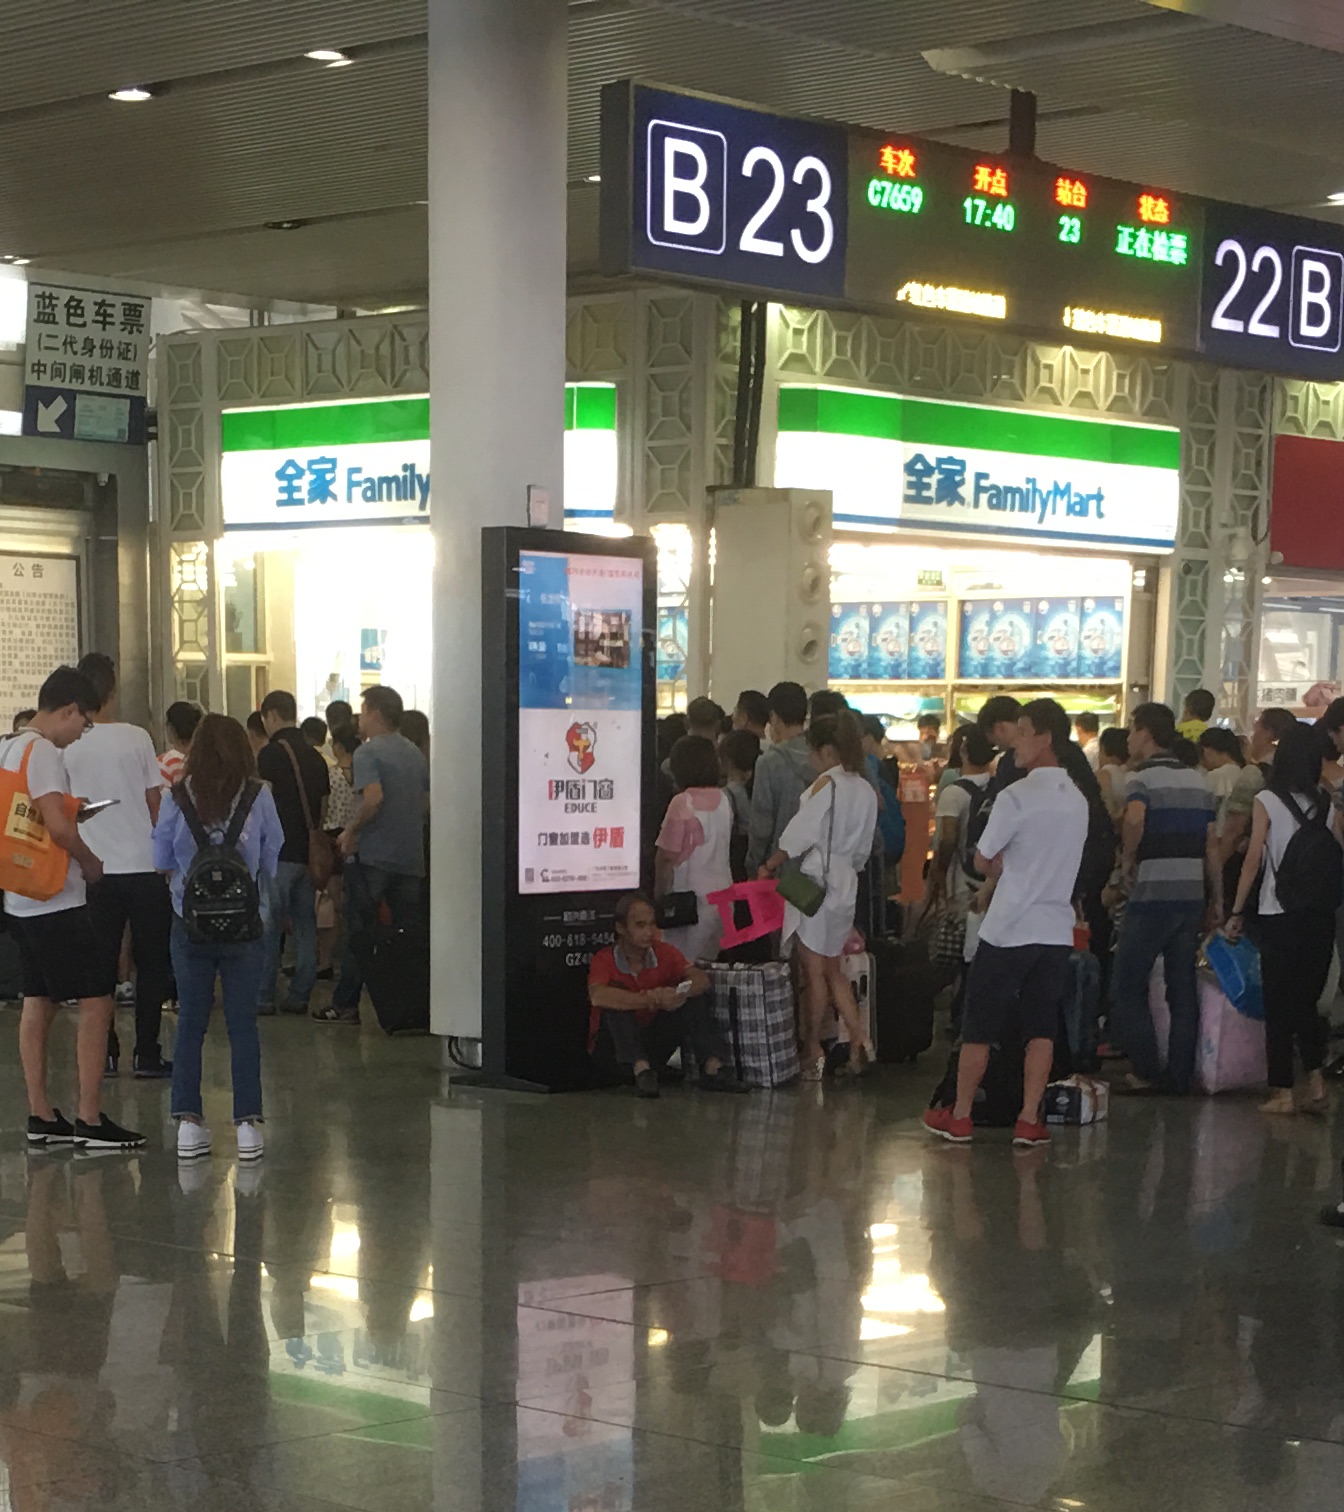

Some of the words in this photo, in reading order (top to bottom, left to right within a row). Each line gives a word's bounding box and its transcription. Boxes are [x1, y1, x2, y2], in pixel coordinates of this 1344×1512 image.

[662, 136, 712, 235] B
[739, 145, 834, 264] 23
[880, 144, 917, 178] 车次
[973, 165, 1008, 197] 开点
[1055, 178, 1087, 208] 站台
[1138, 195, 1171, 224] 状态
[963, 197, 1015, 232] 17:40
[1058, 216, 1081, 244] 23
[1115, 225, 1188, 266] 正在检票
[1210, 238, 1281, 339] 22
[1298, 259, 1332, 339] B
[33, 291, 144, 335] 蓝色车票
[37, 332, 138, 362] (二代身份证)
[31, 359, 141, 391] 中间闸机通道
[275, 456, 338, 507] 全家
[346, 463, 430, 511] Family
[903, 453, 967, 507] 全家
[972, 471, 1105, 524] FamilyMart
[12, 561, 45, 579] 公告
[547, 778, 614, 801] 伊盾门窗
[564, 801, 598, 814] EDUCE
[592, 826, 625, 849] 伊盾
